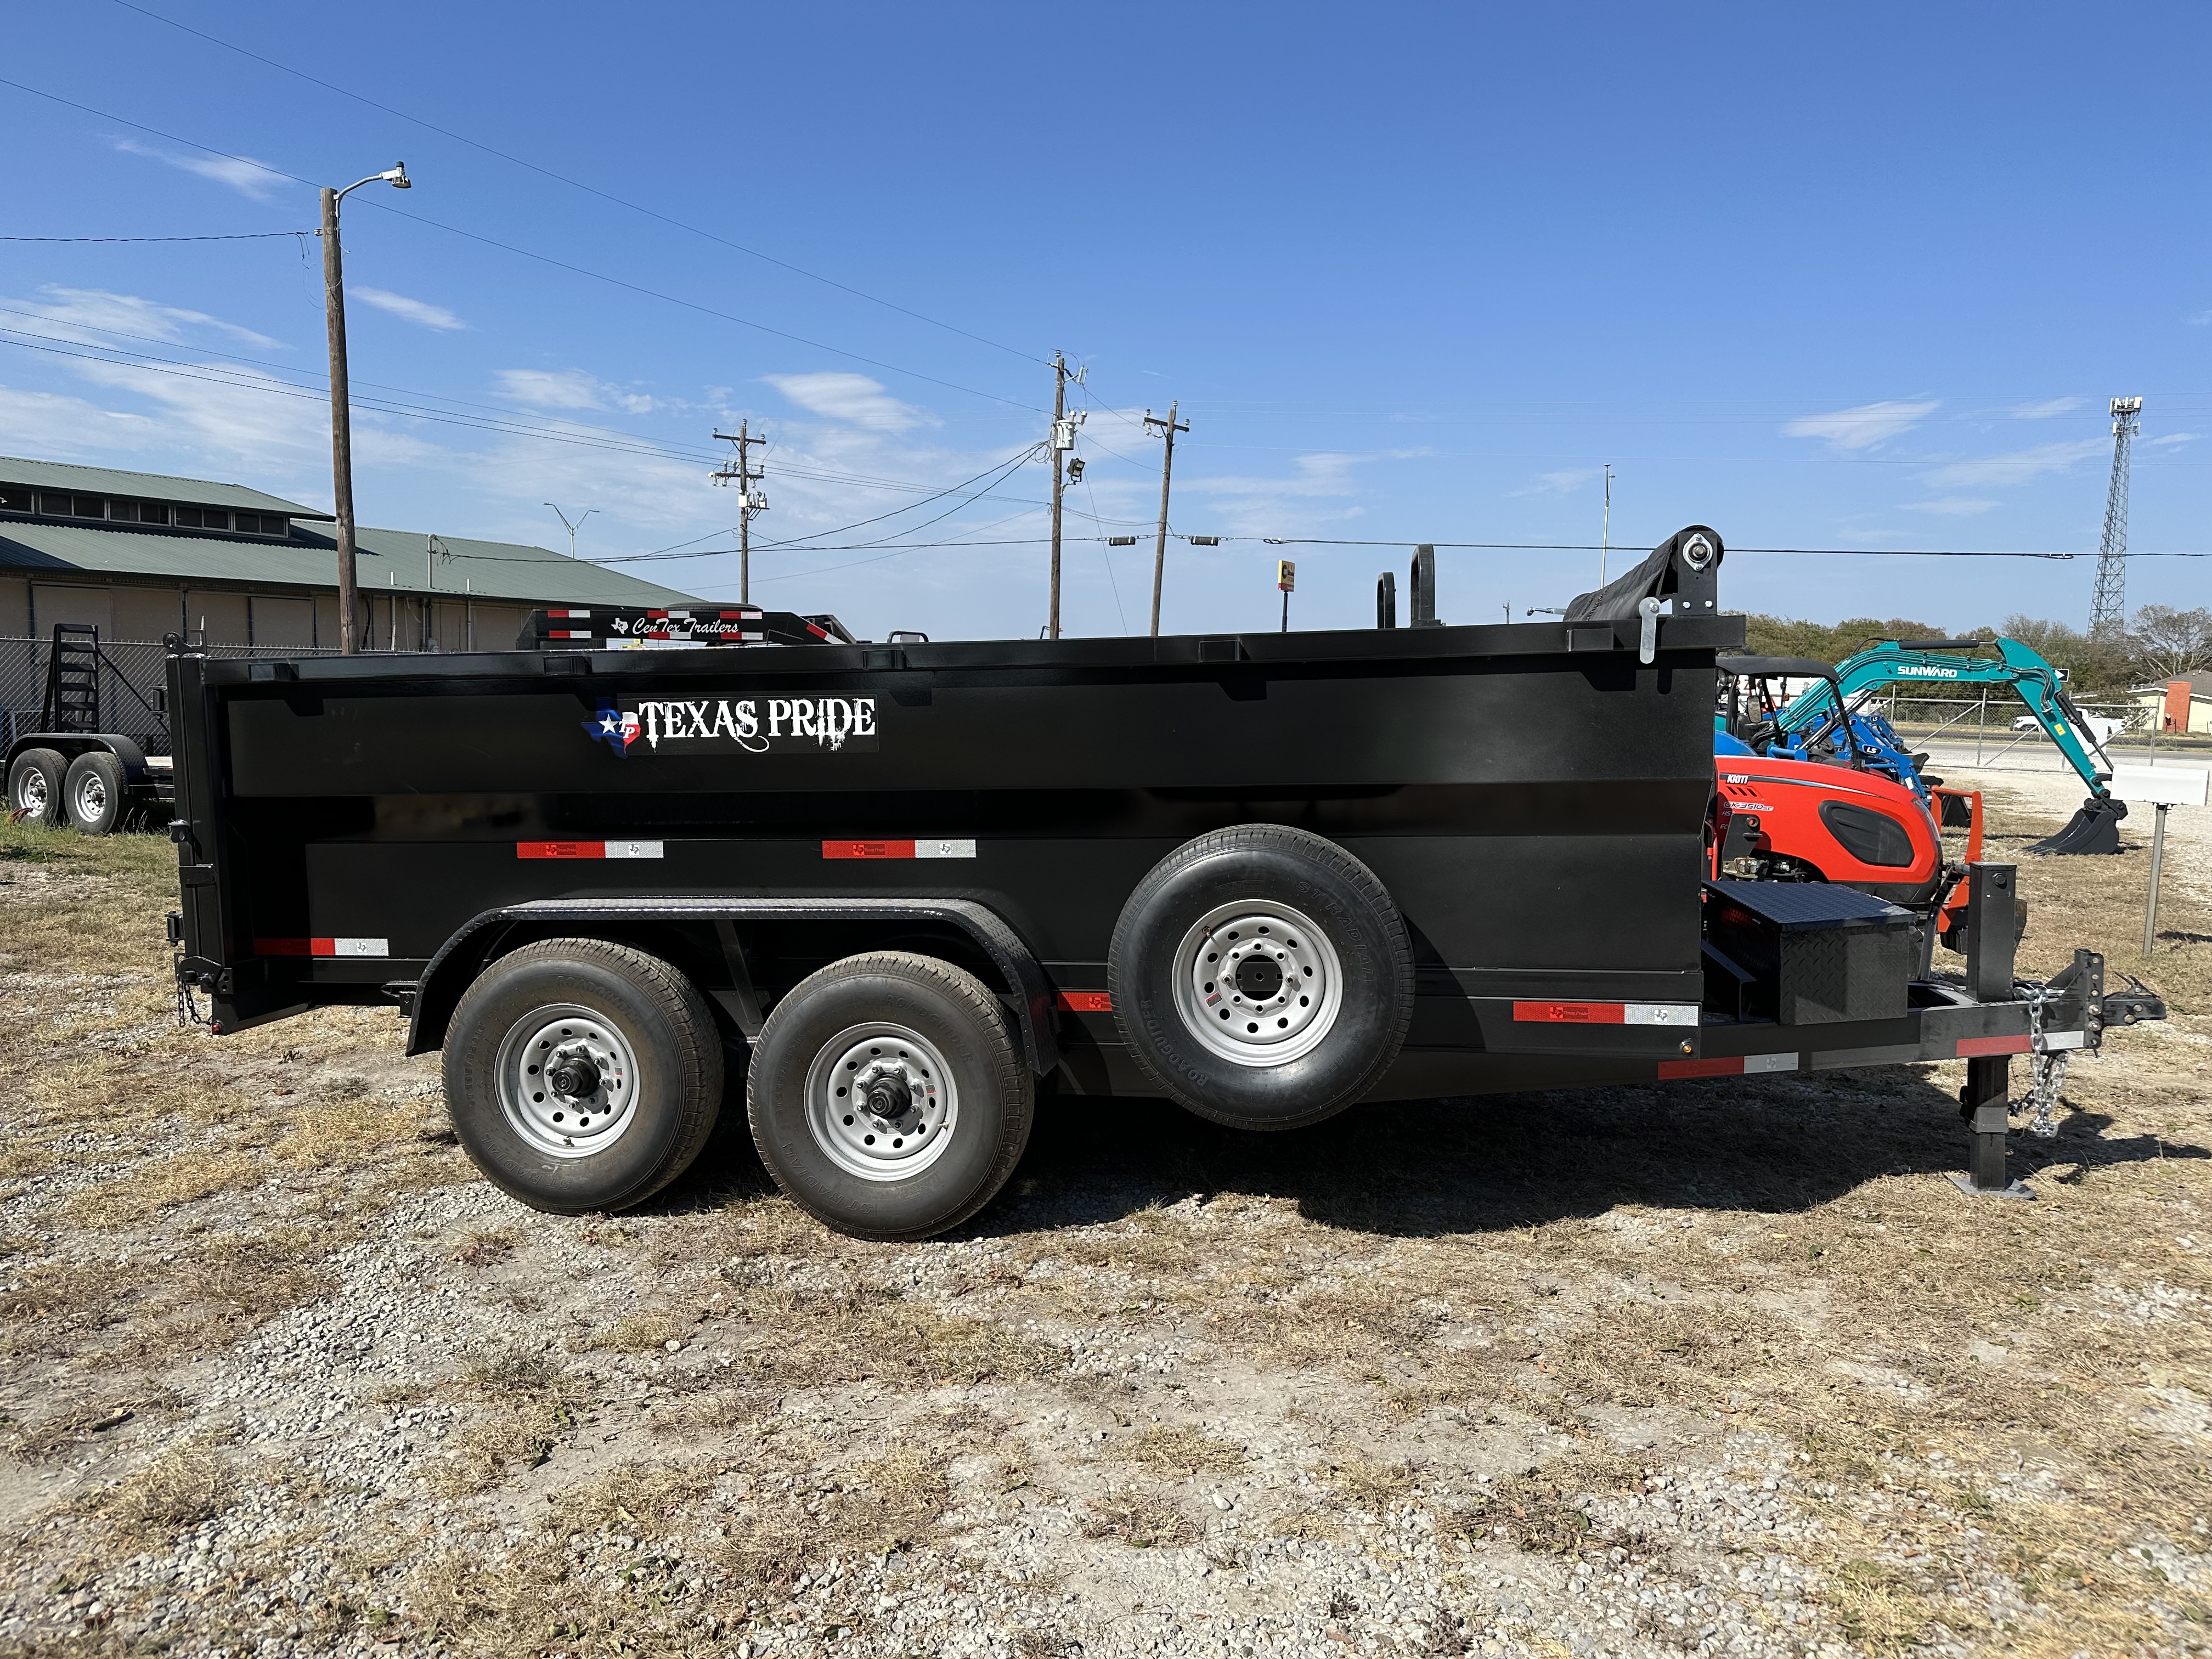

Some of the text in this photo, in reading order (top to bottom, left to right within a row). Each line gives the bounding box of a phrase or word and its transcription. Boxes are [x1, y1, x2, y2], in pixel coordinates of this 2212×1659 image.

[633, 618, 738, 634] CenTex Trailers
[1897, 666, 1957, 678] SUNWARD
[639, 698, 876, 753] TEXAS PRIDE
[1726, 774, 1748, 784] KIOTI
[1297, 881, 1325, 901] ST
[1325, 901, 1374, 979] RADIAL
[556, 975, 640, 1029] ROADGUIDER
[885, 993, 973, 1063] ROADGUIDER
[1142, 998, 1209, 1087] ROADGUIDER
[481, 1133, 572, 1189] ST RADIAL
[784, 1148, 873, 1214] ST RADIAL
